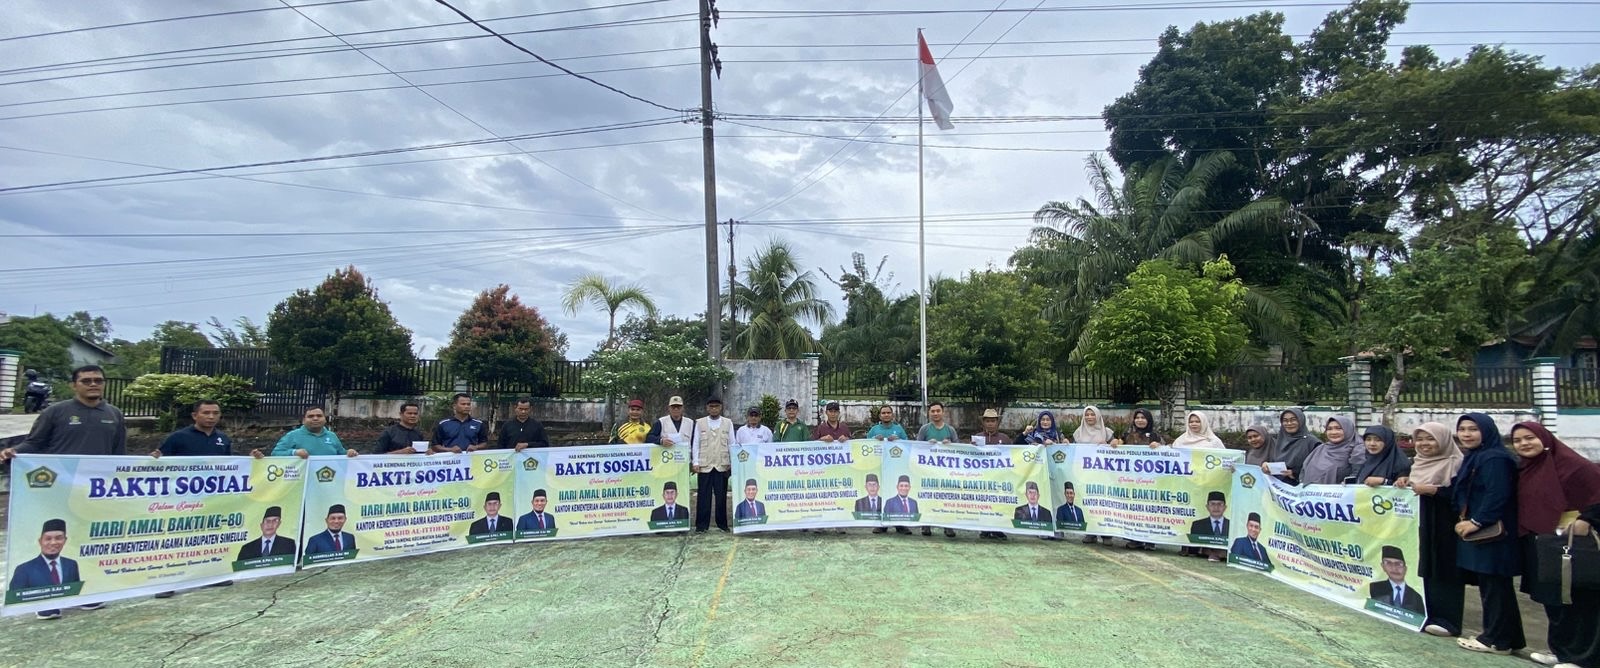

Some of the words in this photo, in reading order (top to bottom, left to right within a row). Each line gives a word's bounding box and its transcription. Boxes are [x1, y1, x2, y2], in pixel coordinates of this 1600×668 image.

[556, 462, 599, 476] BAKTI
[604, 459, 653, 473] SOSIAL
[764, 455, 804, 467] BAKTI
[808, 453, 853, 465] SOSIAL
[918, 455, 960, 468] BAKTI
[964, 458, 1014, 468] SOSIAL
[1083, 457, 1130, 471] BAKTI
[1134, 460, 1193, 475] SOSIAL
[357, 472, 411, 487] BAKTI
[415, 468, 474, 484] SOSIAL
[768, 481, 784, 490] HARI
[786, 480, 804, 489] AMAL
[807, 479, 827, 488] BAKTI
[830, 478, 852, 488] KE-80
[921, 478, 938, 488] HARI
[941, 480, 960, 488] AMAL
[963, 480, 986, 490] BAKTI
[988, 482, 1012, 491] KE-80
[89, 477, 169, 498] BAKTI
[175, 475, 253, 495] SOSIAL
[559, 491, 576, 501] HARI
[579, 489, 599, 499] AMAL
[602, 488, 624, 498] BAKTI
[627, 486, 649, 496] KE-80
[1086, 485, 1104, 494] HARI
[1107, 487, 1129, 498] AMAL
[1132, 489, 1157, 500] BAKTI
[1160, 490, 1188, 502] KE-80
[148, 503, 174, 512] Dalam
[176, 502, 203, 511] Rangka
[361, 505, 382, 516] HARI
[386, 502, 410, 514] AMAL
[413, 500, 439, 512] BAKTI
[442, 497, 469, 509] KE-80
[571, 503, 598, 512] KEMENTERIAN
[614, 501, 635, 509] KABUPATEN
[976, 494, 998, 503] KABUPATEN
[999, 496, 1017, 504] SIMEULUE
[1099, 500, 1128, 510] KEMENTERIAN
[1130, 503, 1144, 511] AGAMA
[1146, 505, 1171, 514] KABUPATEN
[1172, 507, 1195, 517] SIMEULUE
[1295, 501, 1360, 523] SOSIAL
[90, 521, 124, 537] HARI
[127, 519, 164, 534] AMAL
[167, 516, 204, 532] BAKTI
[207, 513, 243, 529] KE-80
[356, 522, 374, 531] KANTOR
[376, 518, 409, 529] KEMENTERIAN
[410, 517, 426, 525] AGAMA
[428, 514, 453, 524] KABUPATEN
[454, 512, 475, 521] SIMEULUE
[411, 526, 450, 535] AL-ITTIHAD
[80, 544, 108, 557] KANTOR
[111, 541, 158, 554] KEMENTERIAN
[160, 539, 183, 551] AGAMA
[185, 535, 218, 548] KABUPATEN
[220, 531, 248, 543] SIMEULUE
[1304, 535, 1330, 552] BAKTI
[1331, 541, 1362, 559] KE-80
[121, 554, 173, 564] KECAMATAN
[1269, 538, 1286, 550] KANTOR
[1321, 555, 1348, 572] KABUPATEN
[1348, 564, 1373, 578] SIMEULUE
[1277, 553, 1290, 561] KUA
